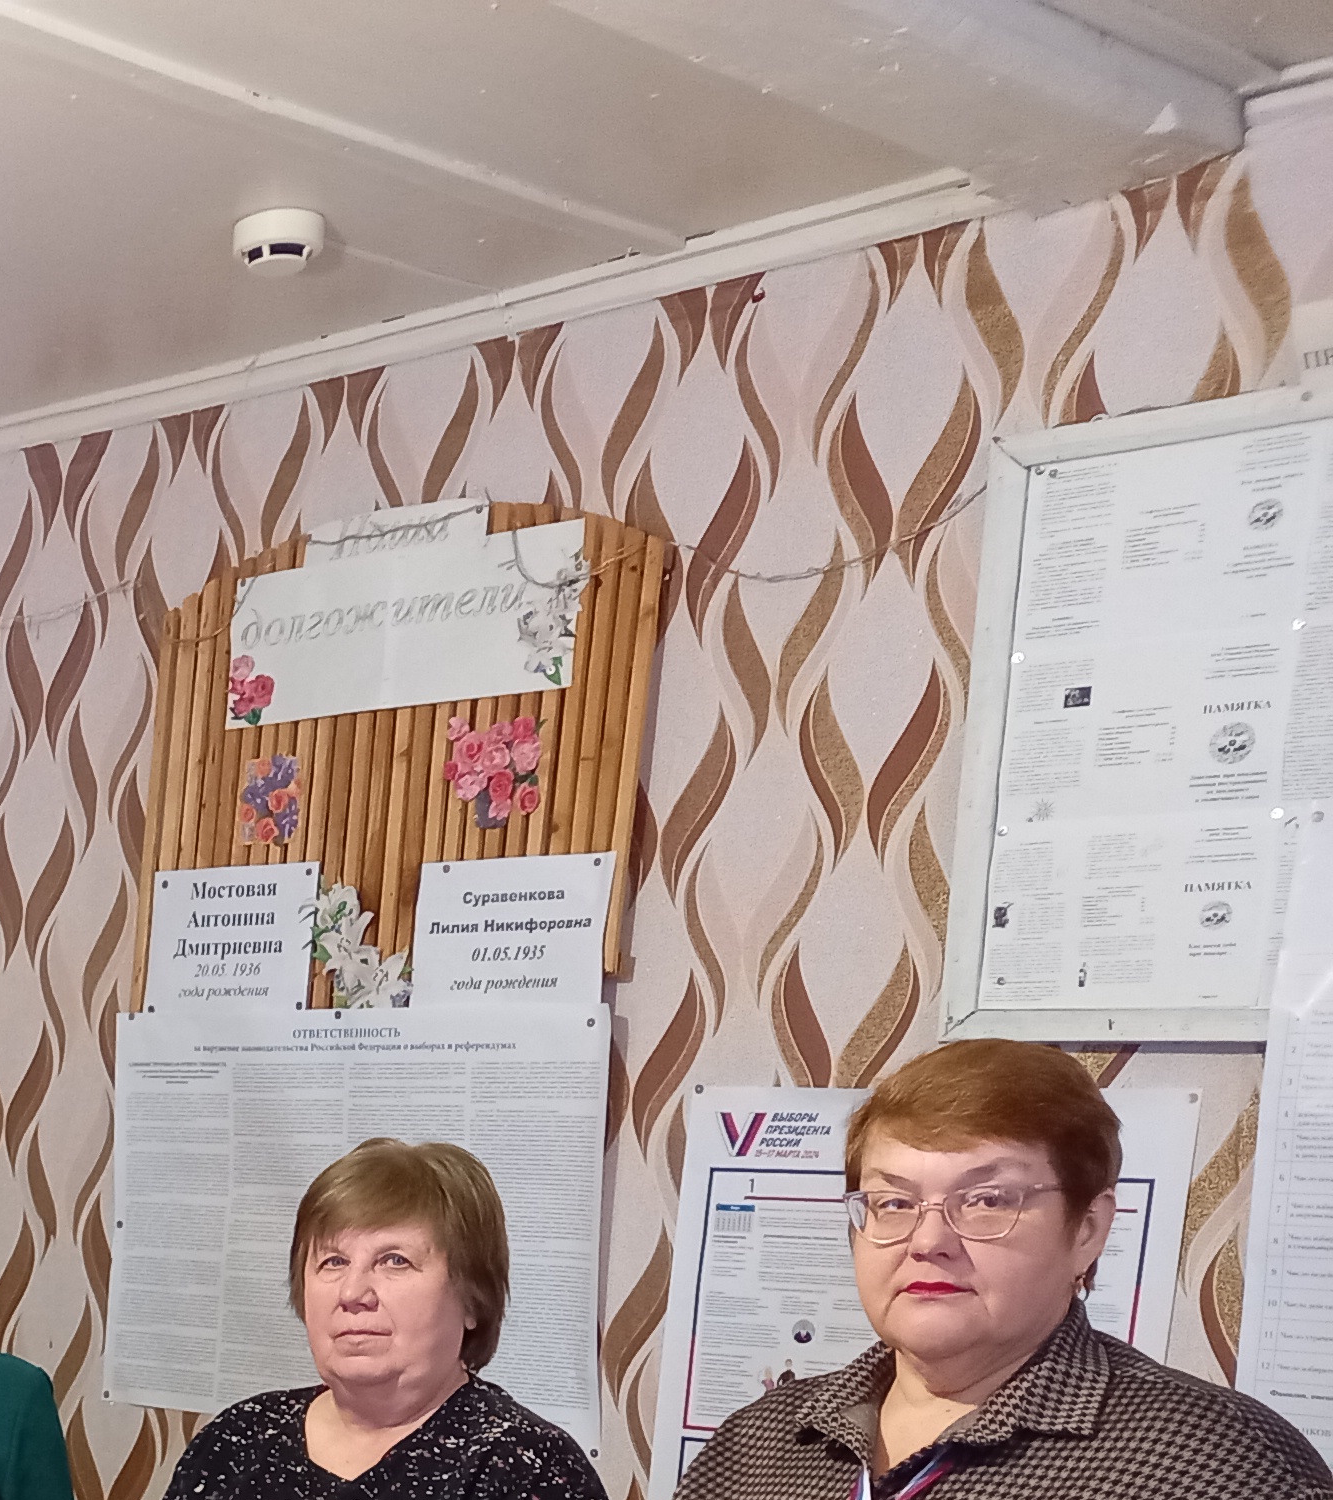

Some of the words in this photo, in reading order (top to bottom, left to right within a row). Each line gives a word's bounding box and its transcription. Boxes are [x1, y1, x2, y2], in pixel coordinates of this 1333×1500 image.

[1203, 700, 1272, 714] ПАМЯТКА
[190, 881, 278, 900] Мостовая
[1184, 880, 1253, 893] ПАМЯТКА
[462, 889, 565, 907] Суравенкова
[186, 911, 275, 928] Антонина
[429, 921, 479, 935] Лилия
[484, 917, 592, 934] Никифоровна
[173, 938, 283, 960] Дмитриевна
[471, 945, 546, 962] 01.05.1935
[232, 962, 262, 977] 1936
[450, 975, 482, 991] года
[483, 974, 558, 994] рождения
[178, 985, 204, 998] года
[205, 984, 270, 1001] рождения
[292, 1027, 401, 1039] ОТВЕТСТВЕННОСТЬ
[410, 1041, 446, 1053] выборах
[454, 1041, 517, 1053] референдумах
[771, 1112, 820, 1123] ВЫБОРЫ
[764, 1125, 832, 1137] ПРЕЗИДЕНТА
[759, 1137, 802, 1148] РОССИИ
